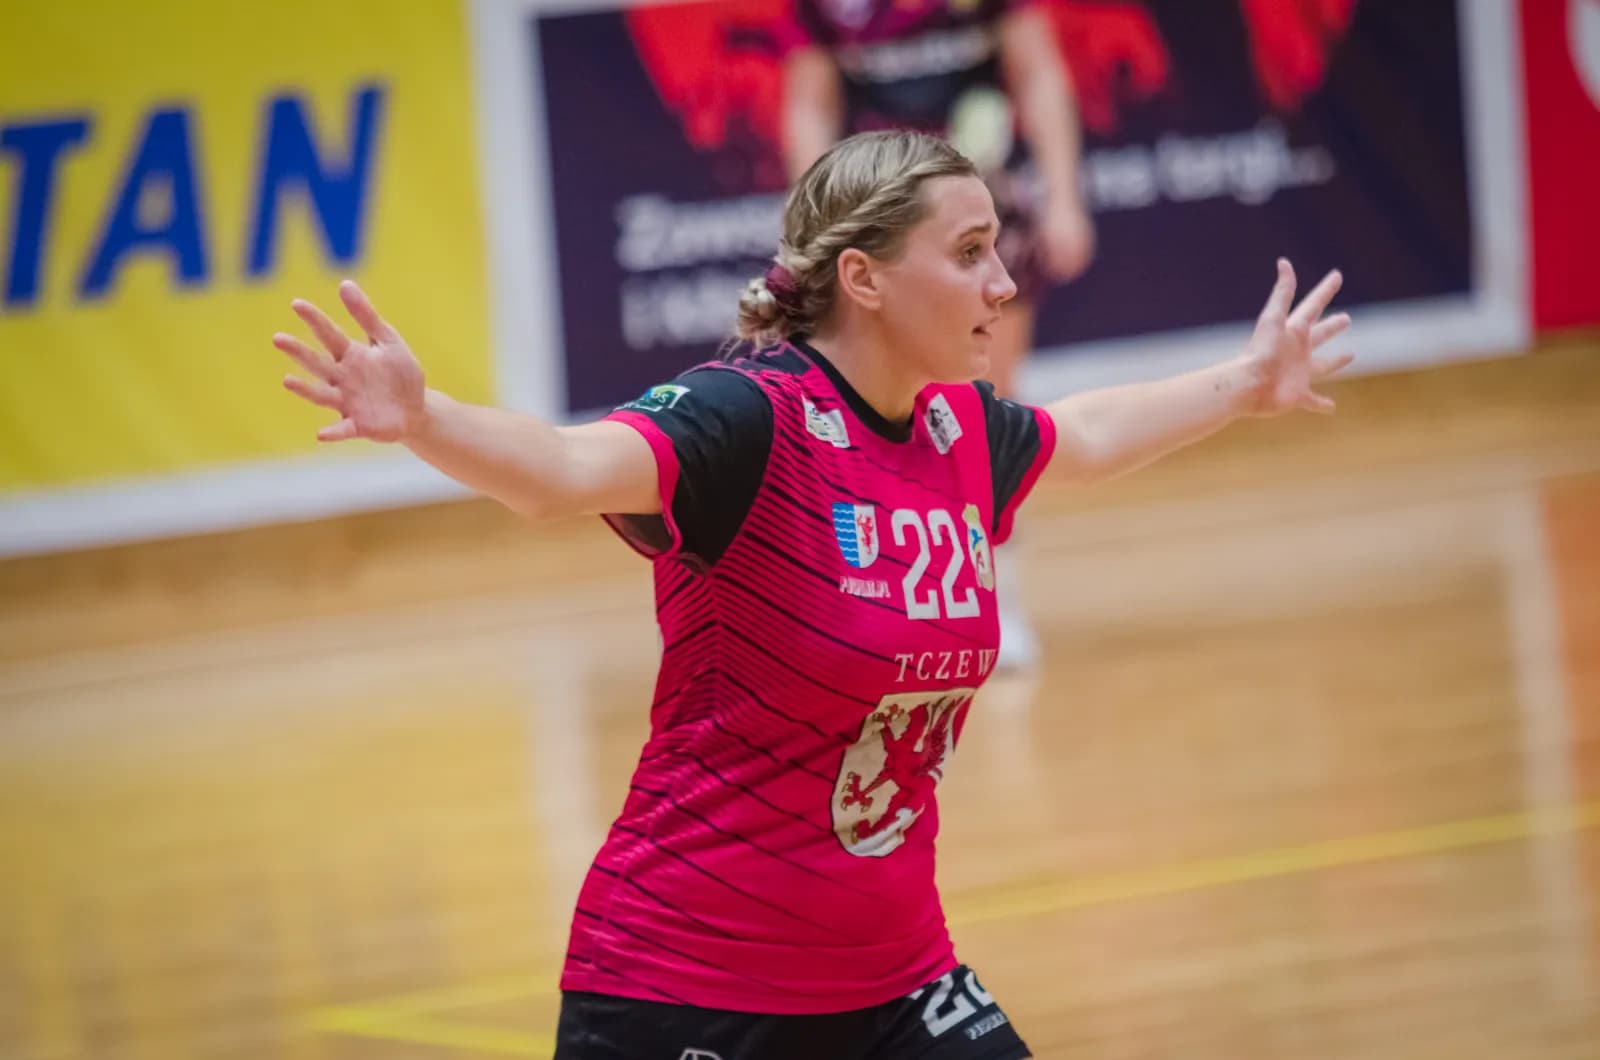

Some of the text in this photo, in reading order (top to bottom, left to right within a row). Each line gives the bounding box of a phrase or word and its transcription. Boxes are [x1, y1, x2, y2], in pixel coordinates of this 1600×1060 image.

[0, 80, 386, 308] TAN
[891, 508, 981, 620] 22
[895, 649, 996, 682] TCZEW
